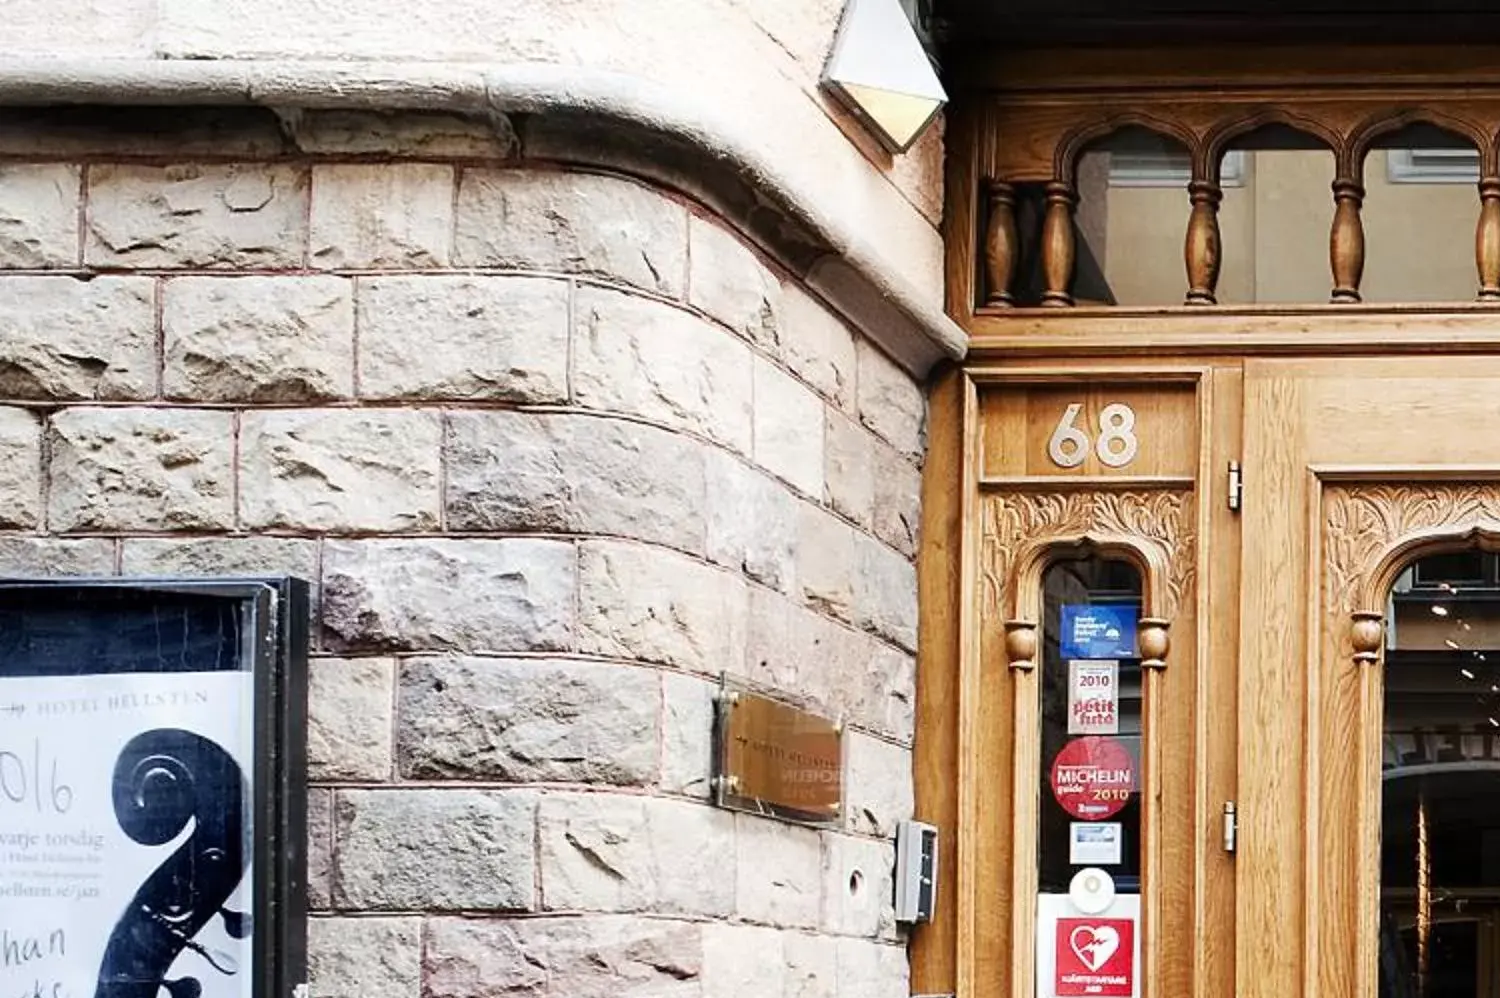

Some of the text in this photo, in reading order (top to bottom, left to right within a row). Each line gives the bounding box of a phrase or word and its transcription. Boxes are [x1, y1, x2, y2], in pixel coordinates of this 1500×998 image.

[1049, 402, 1138, 468] 68
[1079, 675, 1110, 687] 2010
[37, 689, 208, 717] HOTEL HELLSTEN
[1057, 769, 1131, 783] MICHELIN
[1092, 788, 1129, 801] 2010
